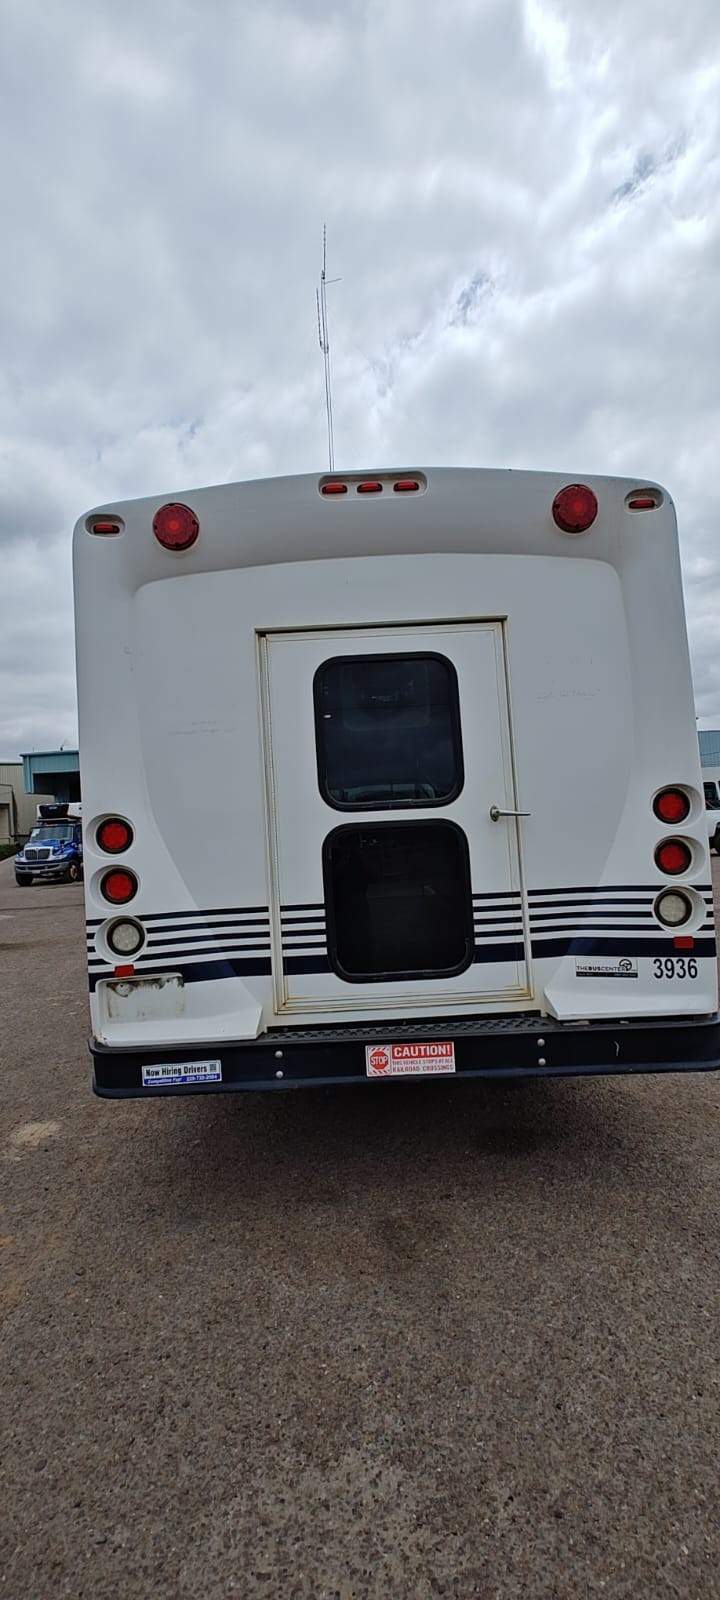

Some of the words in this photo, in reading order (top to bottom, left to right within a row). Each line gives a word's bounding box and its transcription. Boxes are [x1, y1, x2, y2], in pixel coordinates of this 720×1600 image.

[653, 958, 698, 979] 3936
[394, 1044, 452, 1057] CAUTION!
[370, 1055, 388, 1066] STOP
[145, 1068, 160, 1077] Now
[162, 1066, 182, 1076] Hiring
[183, 1065, 208, 1074] Drivers
[392, 1065, 420, 1073] RAILROAD
[422, 1064, 454, 1072] CROSSINGS
